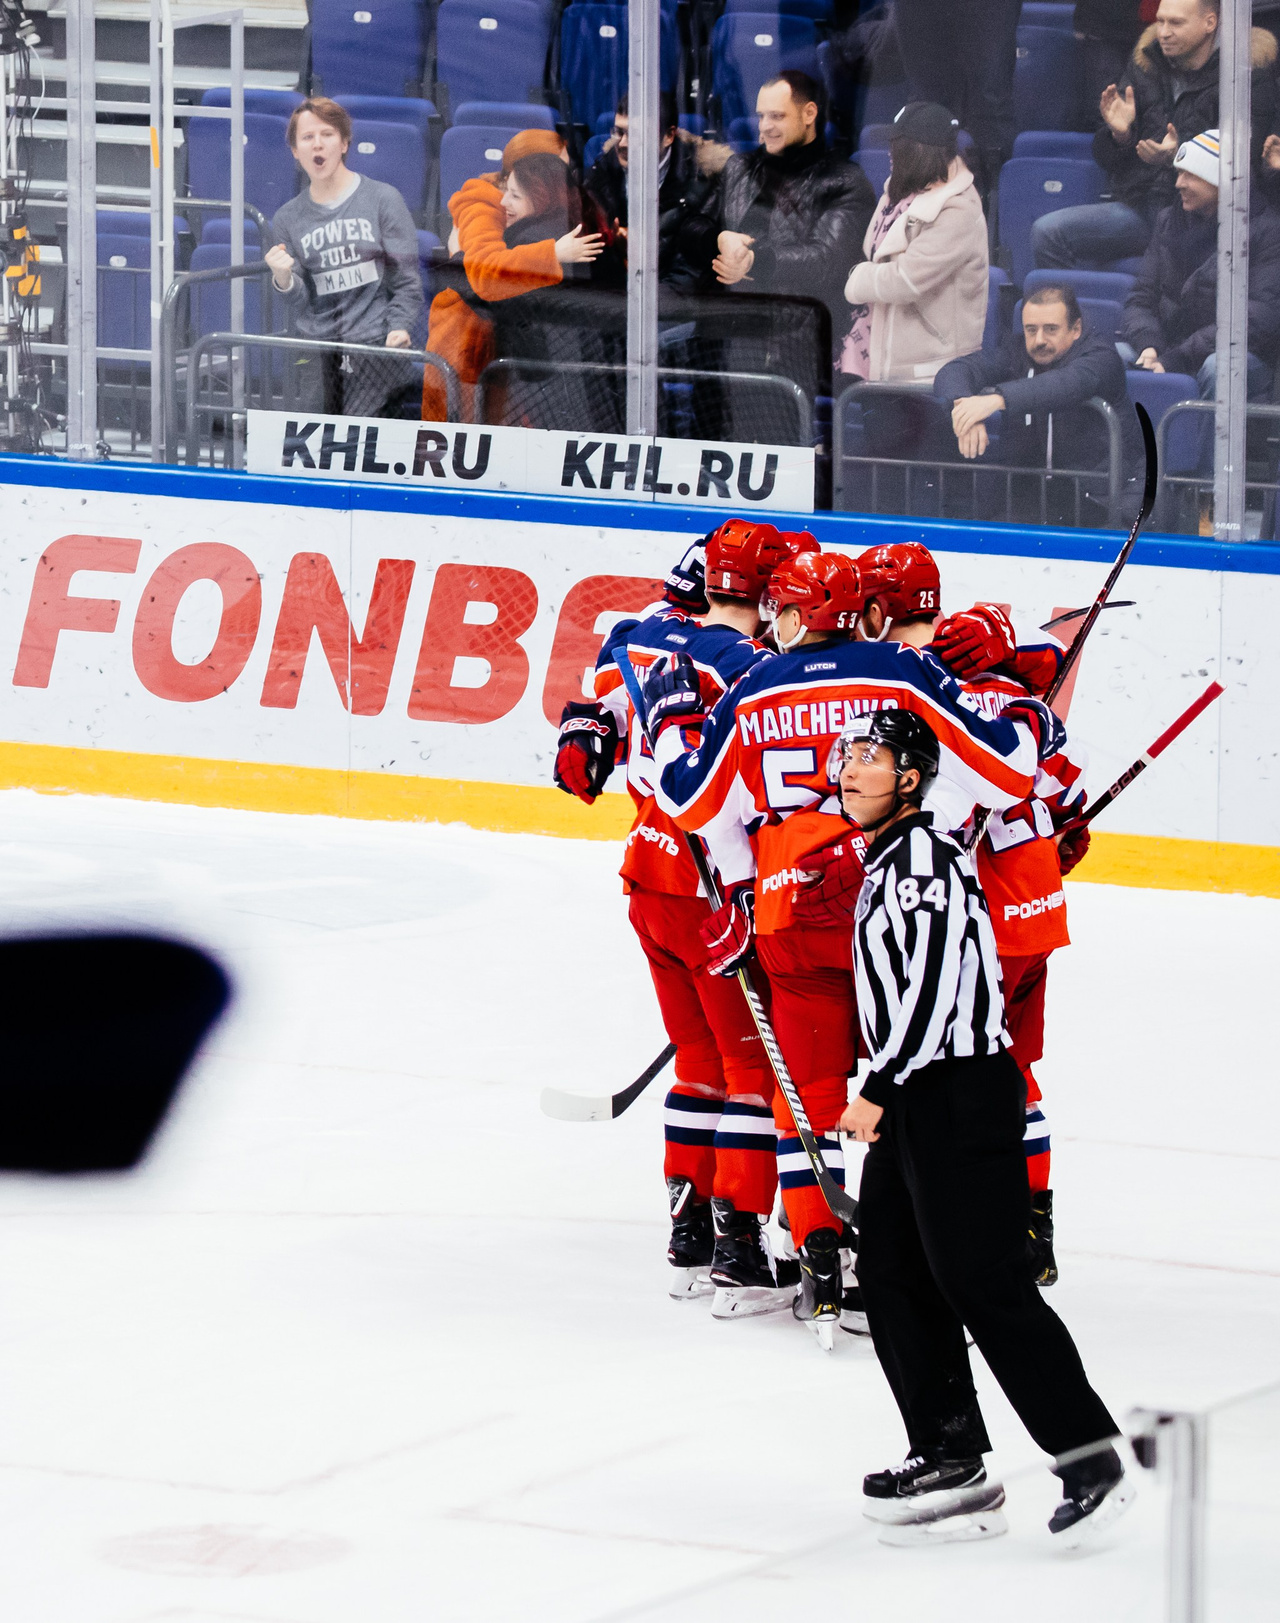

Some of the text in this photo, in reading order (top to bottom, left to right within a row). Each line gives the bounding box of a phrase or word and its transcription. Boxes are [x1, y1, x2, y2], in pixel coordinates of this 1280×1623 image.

[300, 217, 376, 259] POWER
[320, 243, 361, 268] FULL
[324, 268, 363, 291] MAIN
[282, 421, 779, 501] KHL.RU KHL.RU
[722, 572, 731, 589] 6
[920, 591, 935, 609] 25
[837, 612, 858, 629] 53
[804, 663, 837, 673] LUTCH
[896, 877, 948, 912] 84
